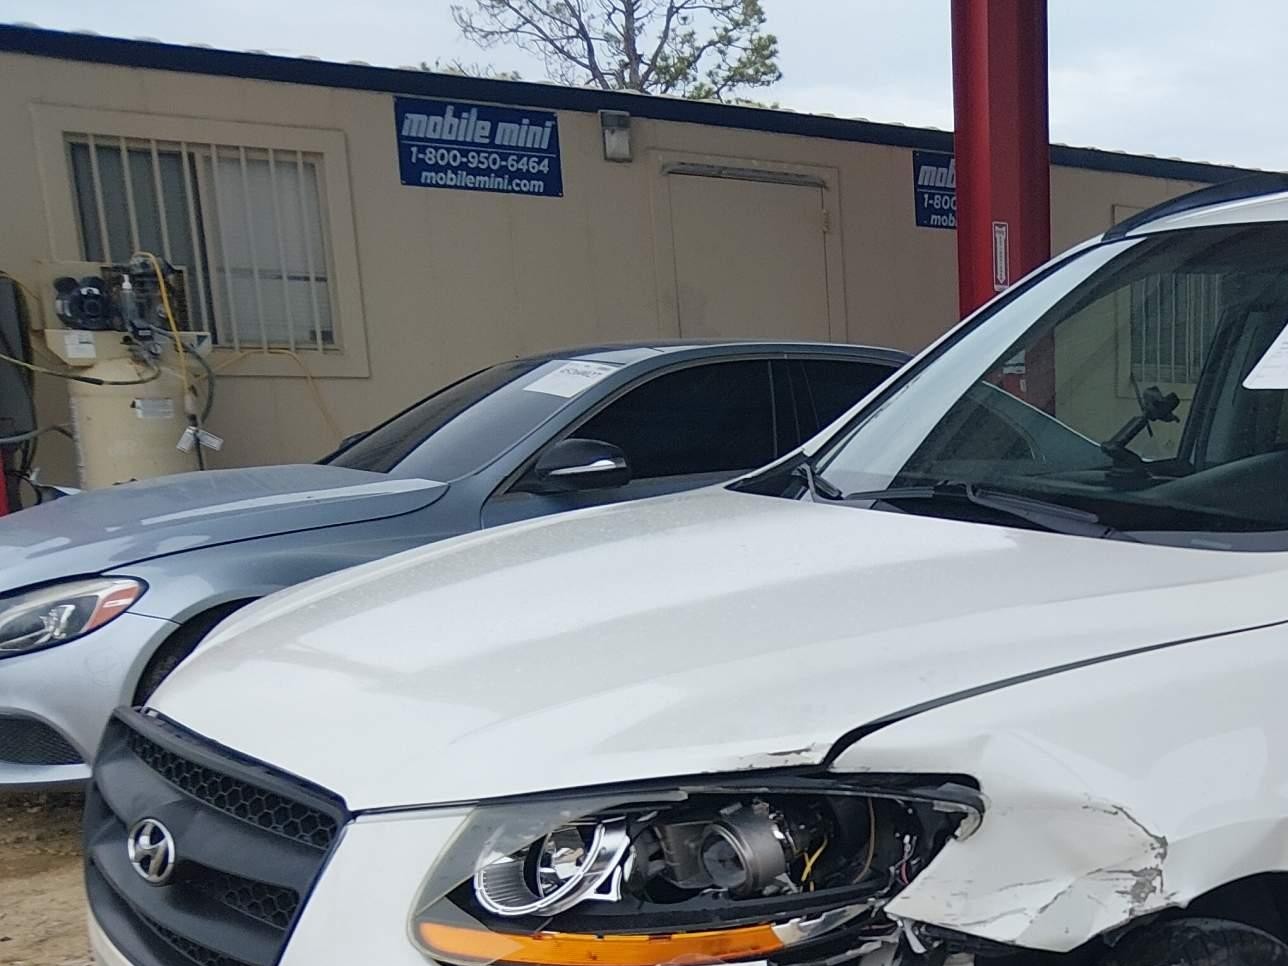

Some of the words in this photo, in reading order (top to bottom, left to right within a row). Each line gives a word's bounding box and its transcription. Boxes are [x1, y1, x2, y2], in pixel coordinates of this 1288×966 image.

[401, 105, 491, 144] mobile
[494, 118, 554, 149] mini
[410, 146, 549, 174] 1-800-950-6464
[420, 170, 544, 192] mobilemini.com
